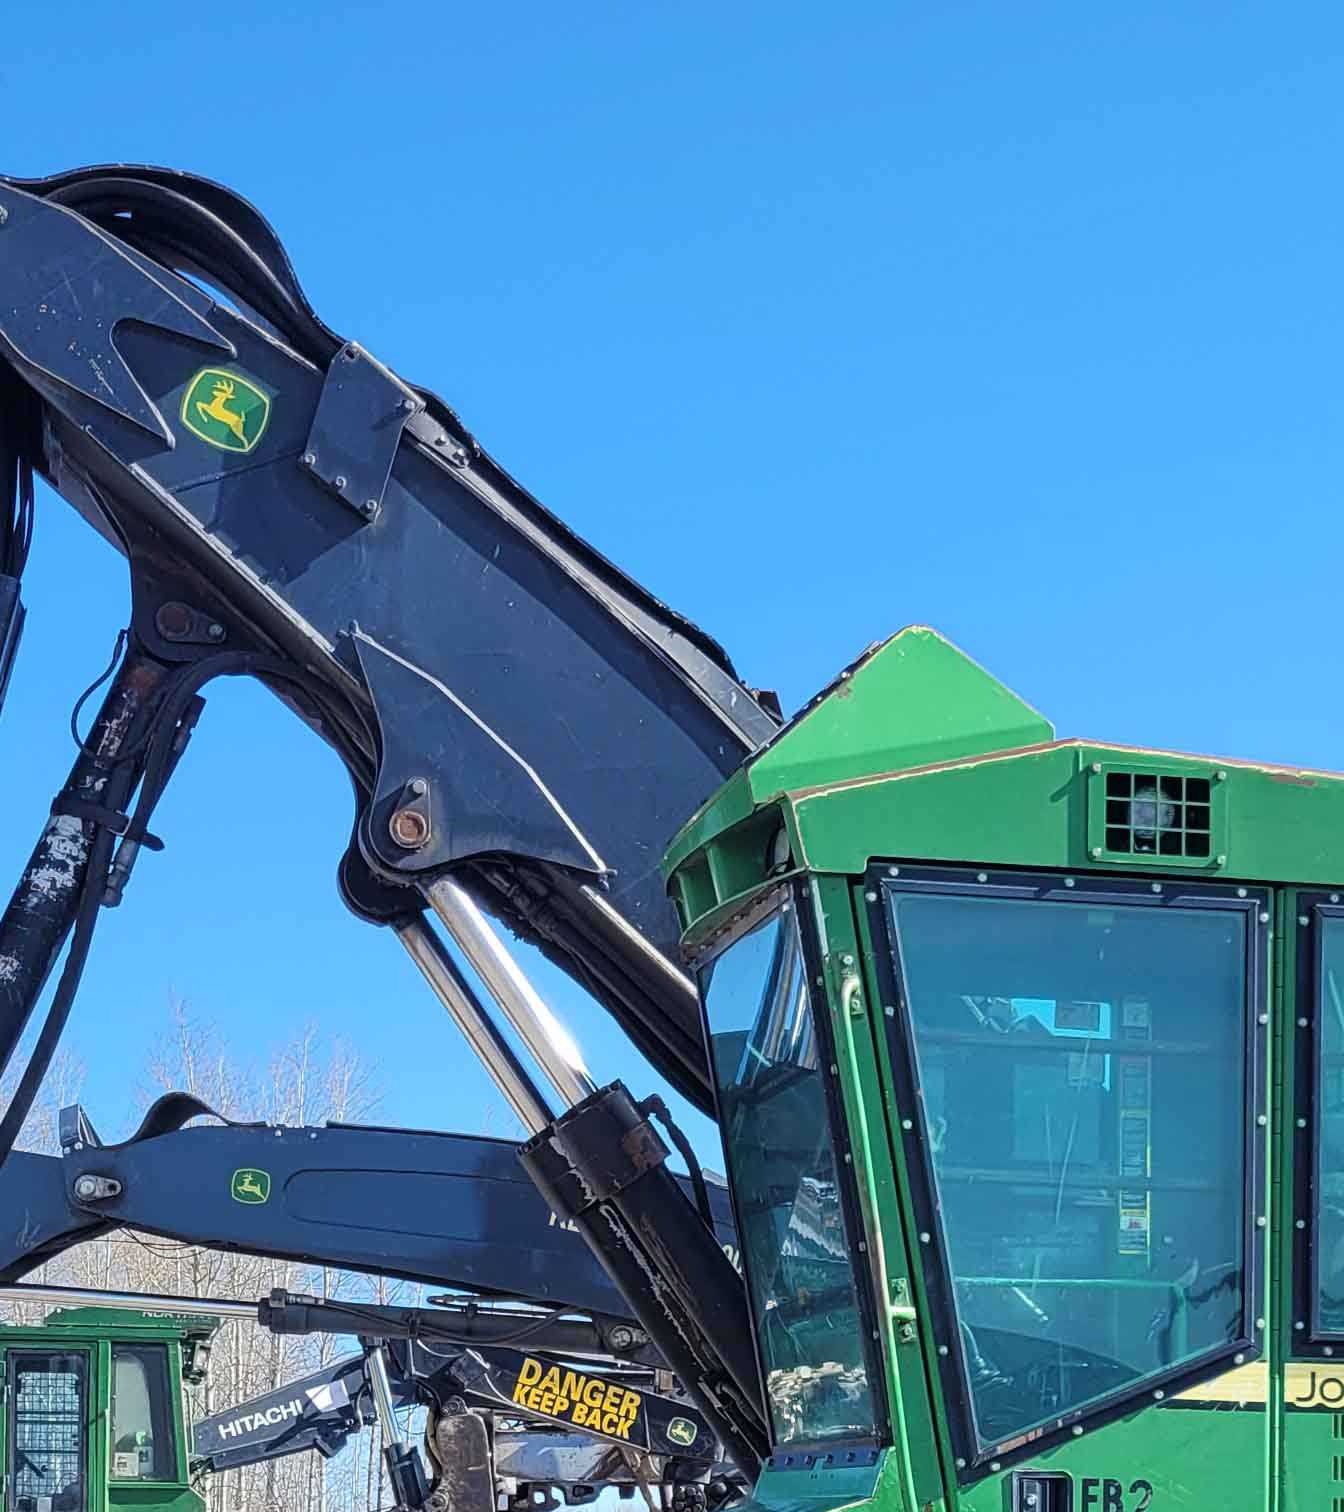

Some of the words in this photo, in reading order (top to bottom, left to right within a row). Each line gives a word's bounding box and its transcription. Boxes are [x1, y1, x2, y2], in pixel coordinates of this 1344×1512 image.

[512, 1383, 570, 1417] KEEP
[571, 1402, 635, 1440] BACK
[518, 1357, 642, 1420] DANGER
[218, 1399, 304, 1440] HITACHI
